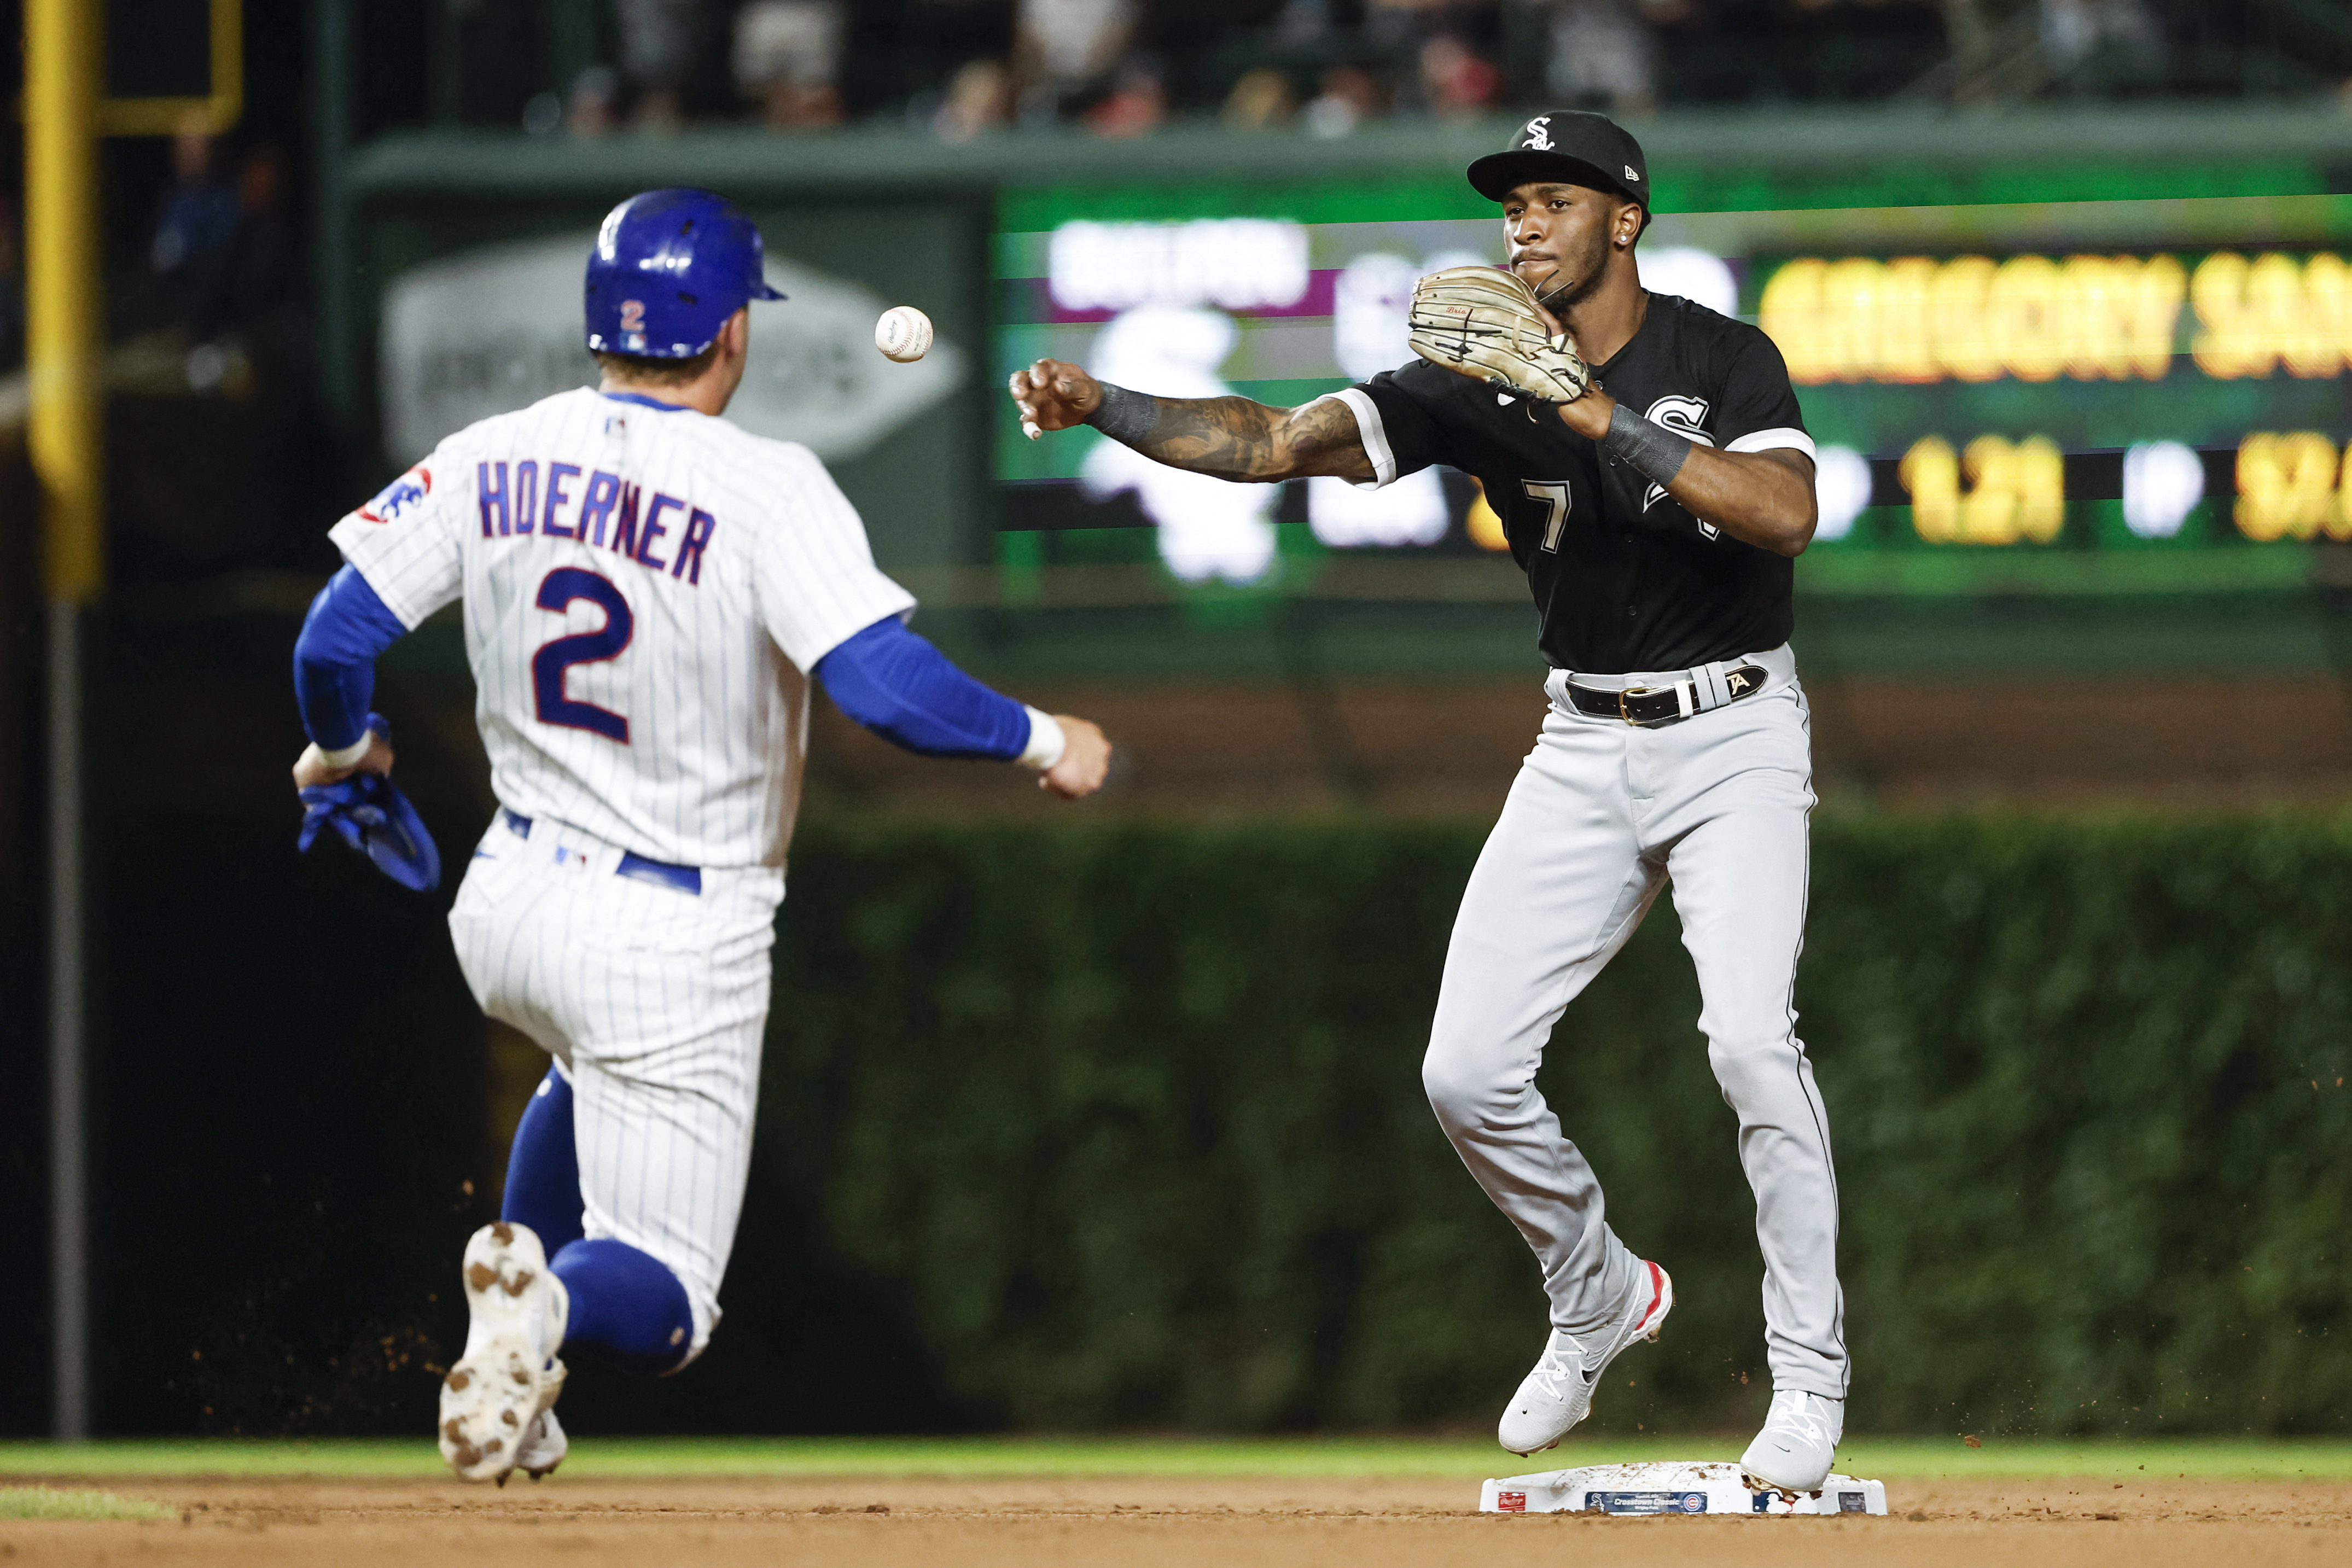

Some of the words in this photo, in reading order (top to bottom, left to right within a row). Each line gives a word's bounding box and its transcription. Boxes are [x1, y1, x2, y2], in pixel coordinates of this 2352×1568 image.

[620, 300, 645, 331] 2
[478, 460, 716, 586] HOERNER
[1521, 479, 1572, 554] 7
[531, 567, 633, 745] 2
[1654, 1497, 1680, 1506] Classic
